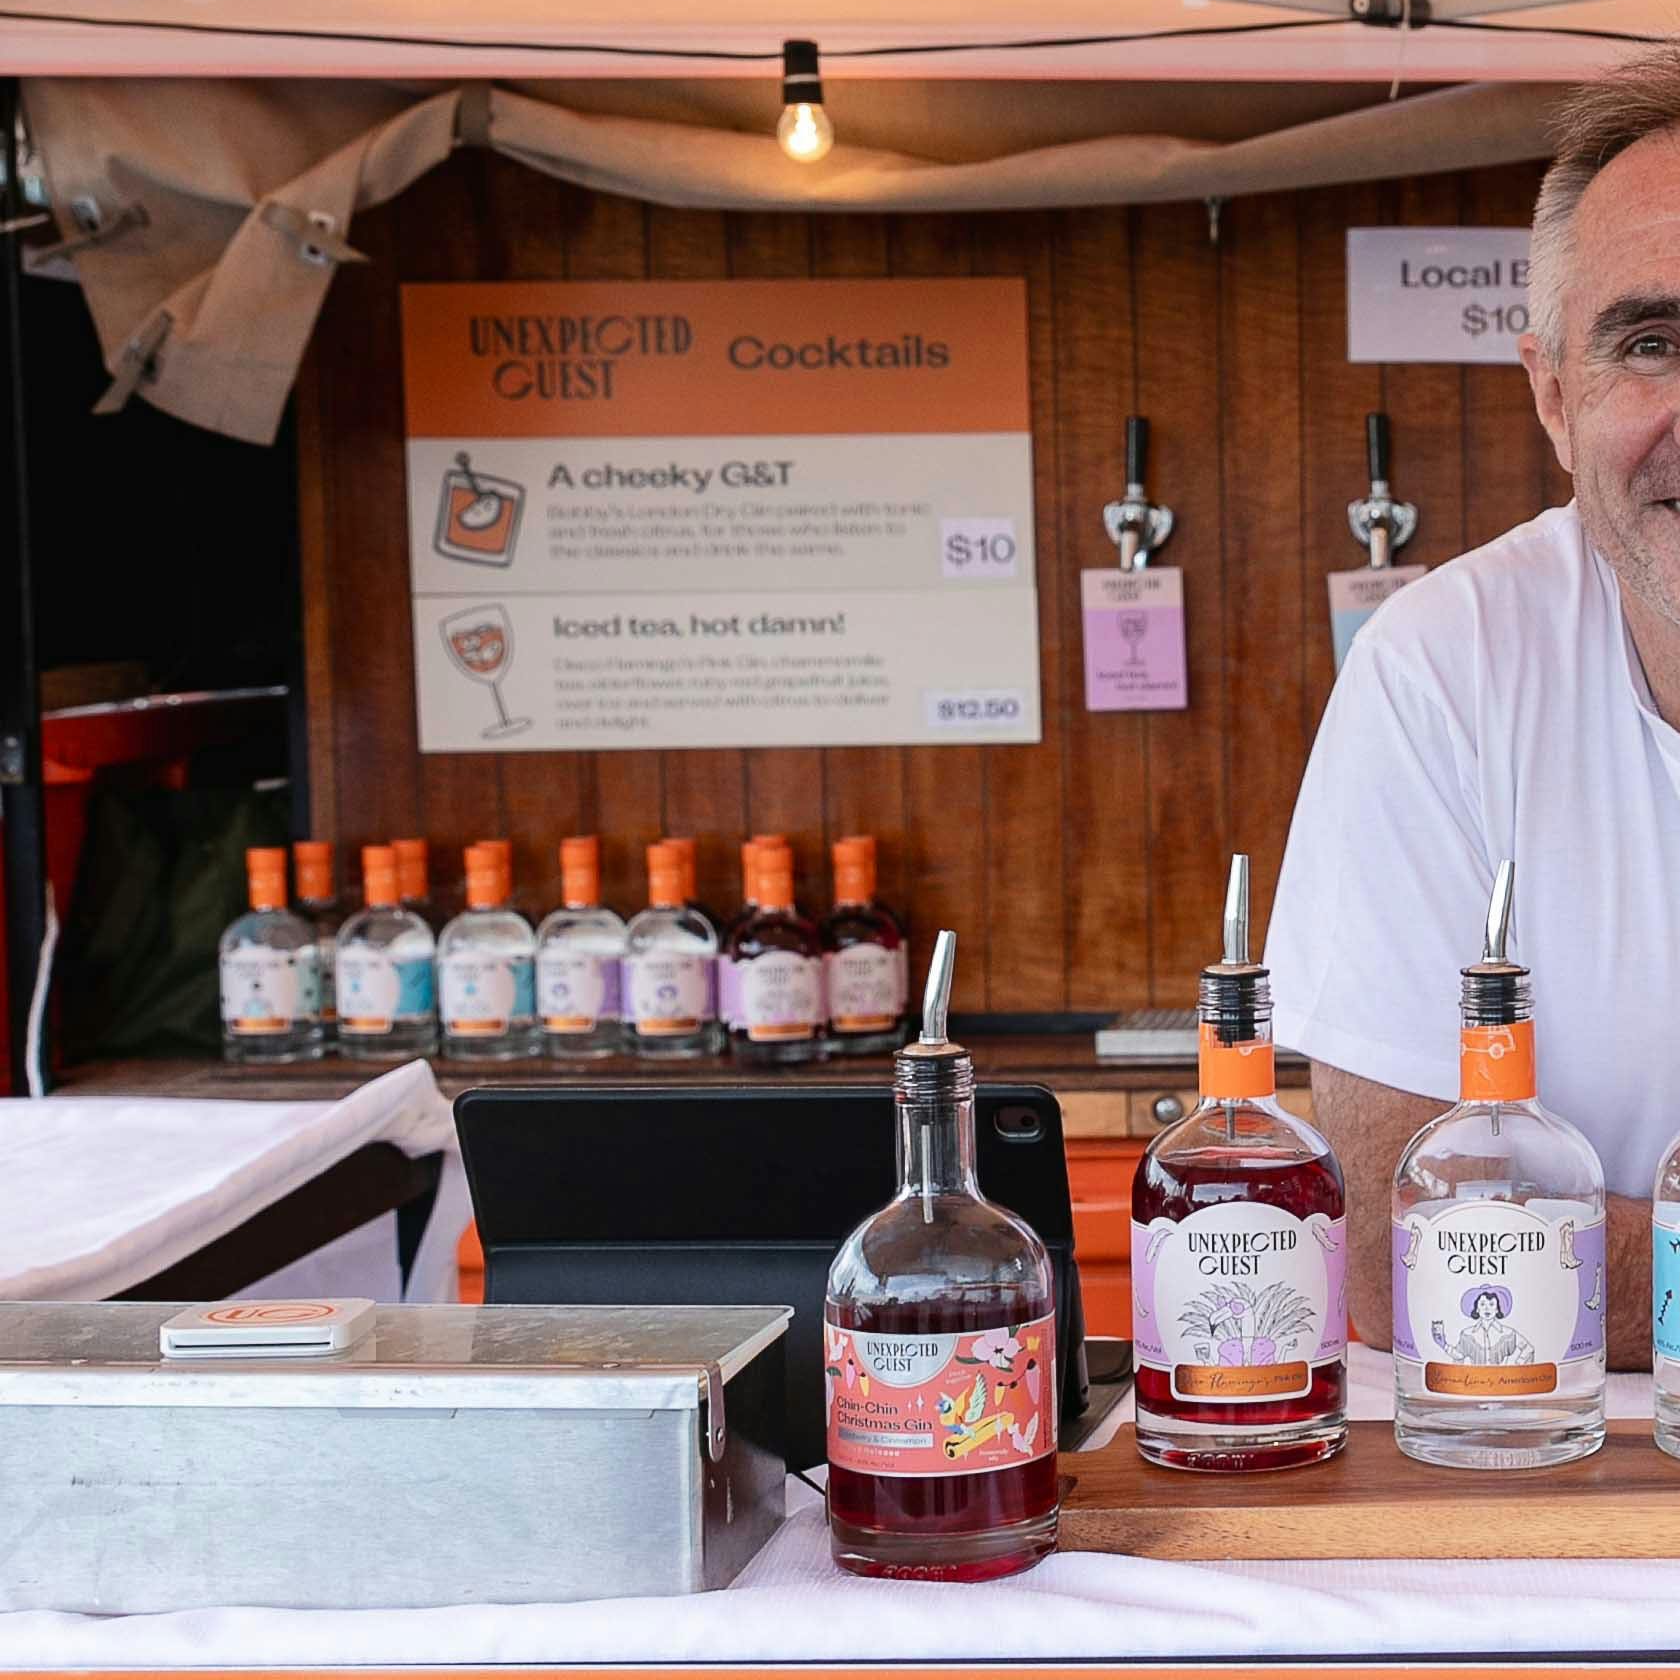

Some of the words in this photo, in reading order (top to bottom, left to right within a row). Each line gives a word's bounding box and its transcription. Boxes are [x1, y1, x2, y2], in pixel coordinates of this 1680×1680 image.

[1400, 258, 1502, 288] Local
[468, 314, 694, 357] UNEXPECTED
[728, 334, 950, 369] Cocktails
[493, 359, 616, 401] GUEST
[546, 463, 575, 489] A
[581, 462, 714, 494] cheeky
[720, 461, 795, 488] G&T
[944, 532, 1016, 568] $10
[552, 616, 622, 639] Iced
[627, 617, 683, 639] tea,
[690, 614, 740, 636] hot
[747, 613, 847, 636] damn!
[937, 697, 1019, 721] $12.50
[1187, 1229, 1298, 1254] UNEXPECTED
[1437, 1230, 1546, 1254] UNEXPECTED
[1198, 1254, 1261, 1276] GUEST
[1447, 1253, 1509, 1276] GUEST
[866, 1340, 939, 1358] UNEXPECTED
[873, 1357, 912, 1372] GUEST
[836, 1395, 899, 1416] Chin-Chin
[838, 1412, 902, 1431] Christmas
[903, 1418, 933, 1431] Gin
